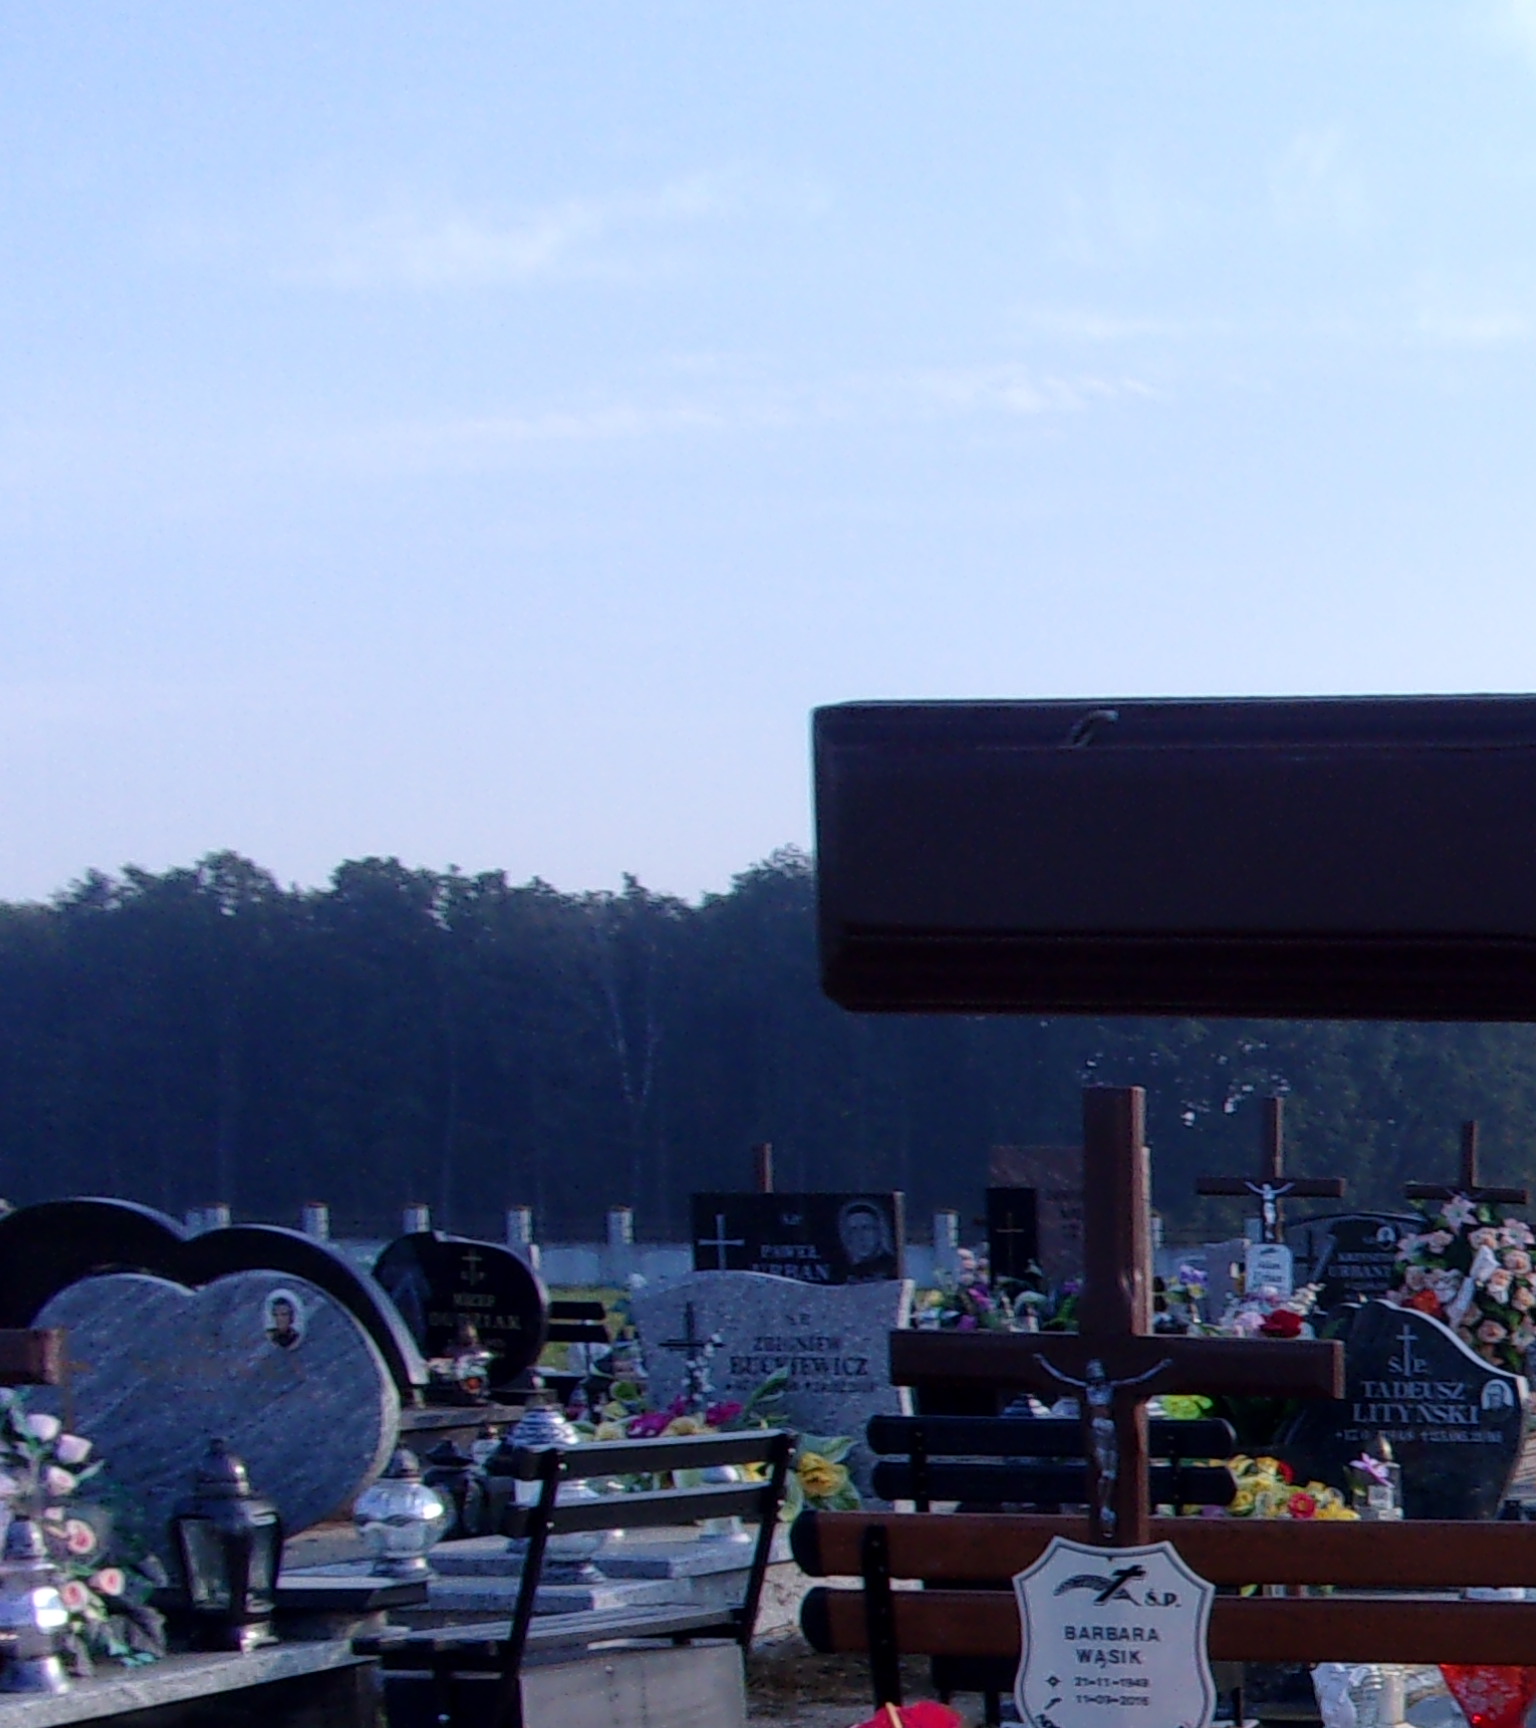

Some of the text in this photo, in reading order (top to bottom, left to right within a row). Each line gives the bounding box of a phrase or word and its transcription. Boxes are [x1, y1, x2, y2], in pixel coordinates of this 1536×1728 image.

[1361, 1381, 1466, 1400] TADEUSZ
[1064, 1625, 1160, 1642] BARBARA
[1076, 1649, 1143, 1668] WĄSIK
